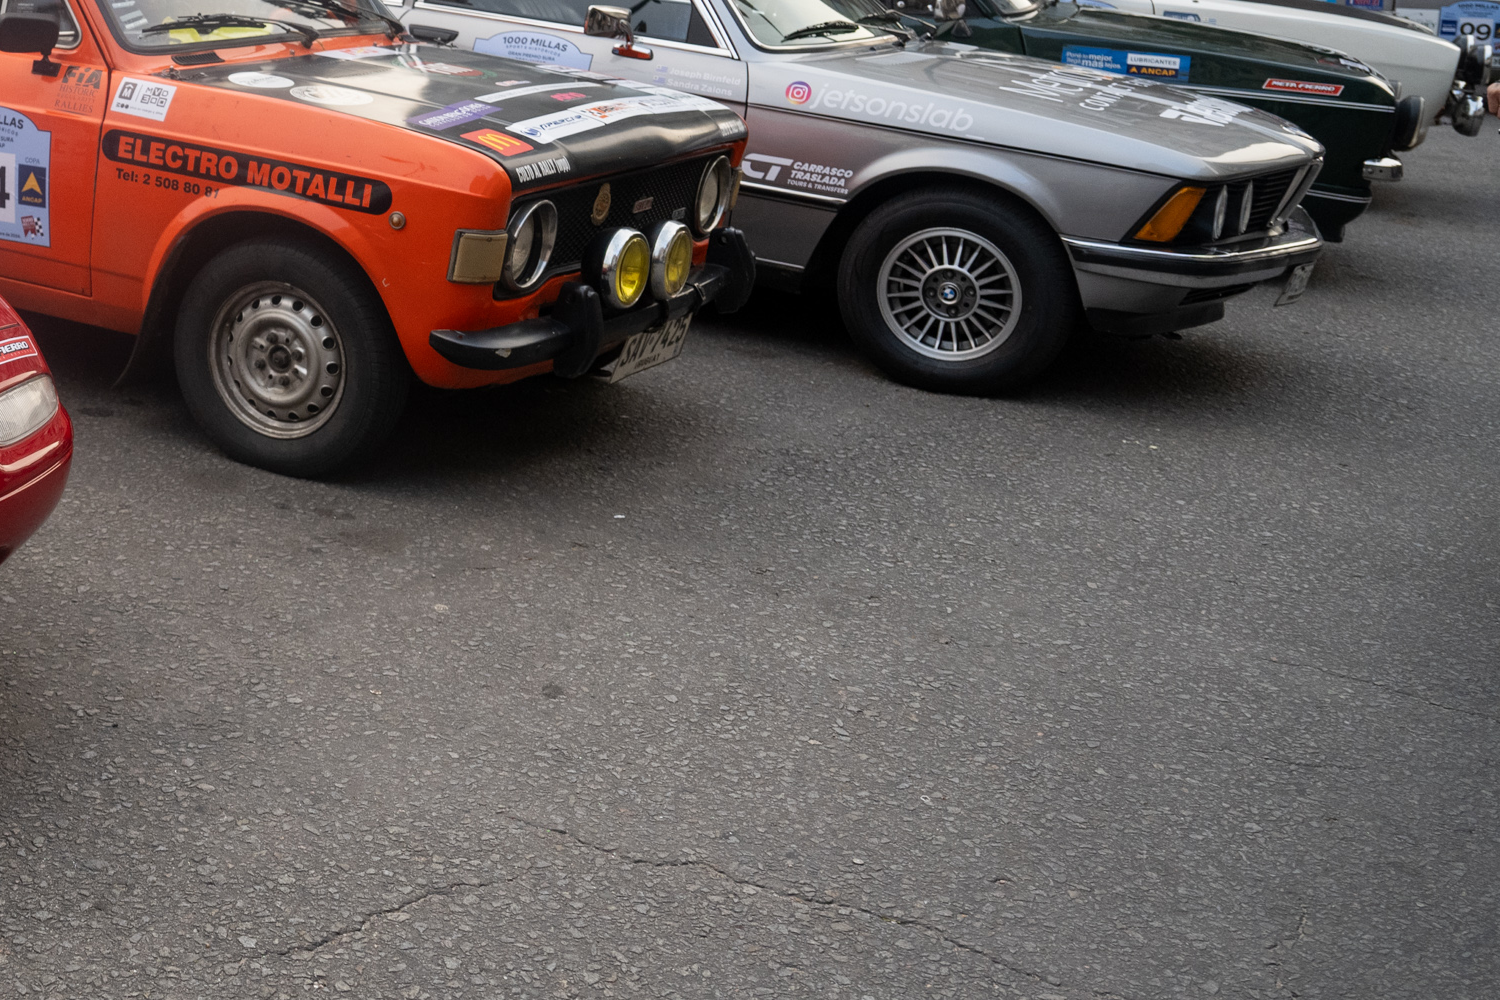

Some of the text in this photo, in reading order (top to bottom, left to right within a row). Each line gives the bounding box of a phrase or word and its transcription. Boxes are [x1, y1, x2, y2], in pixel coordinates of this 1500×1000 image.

[1460, 21, 1492, 41] 09
[502, 35, 568, 53] 1000 MILLAS
[1088, 52, 1113, 64] mejor
[1129, 56, 1178, 67] LUBRICANTES
[668, 66, 741, 87] Joseph Birnfeld
[1140, 66, 1177, 77] ANCAP
[59, 83, 98, 97] HISTORIC
[666, 77, 699, 92] Sandra
[1271, 79, 1336, 93] META FIERRO
[54, 99, 93, 113] RALLIES
[24, 156, 41, 165] COPA
[116, 135, 373, 209] ELECTRO MOTALLI
[516, 163, 535, 184] CULTO
[541, 158, 556, 177] RALLY
[793, 160, 854, 178] CARRASCO
[115, 167, 220, 199] Tel: 2 508 80 81
[786, 178, 808, 189] TOURS
[813, 182, 849, 195] TRANSFERS
[790, 169, 846, 188] TRASLADA
[21, 195, 43, 205] ANCAP
